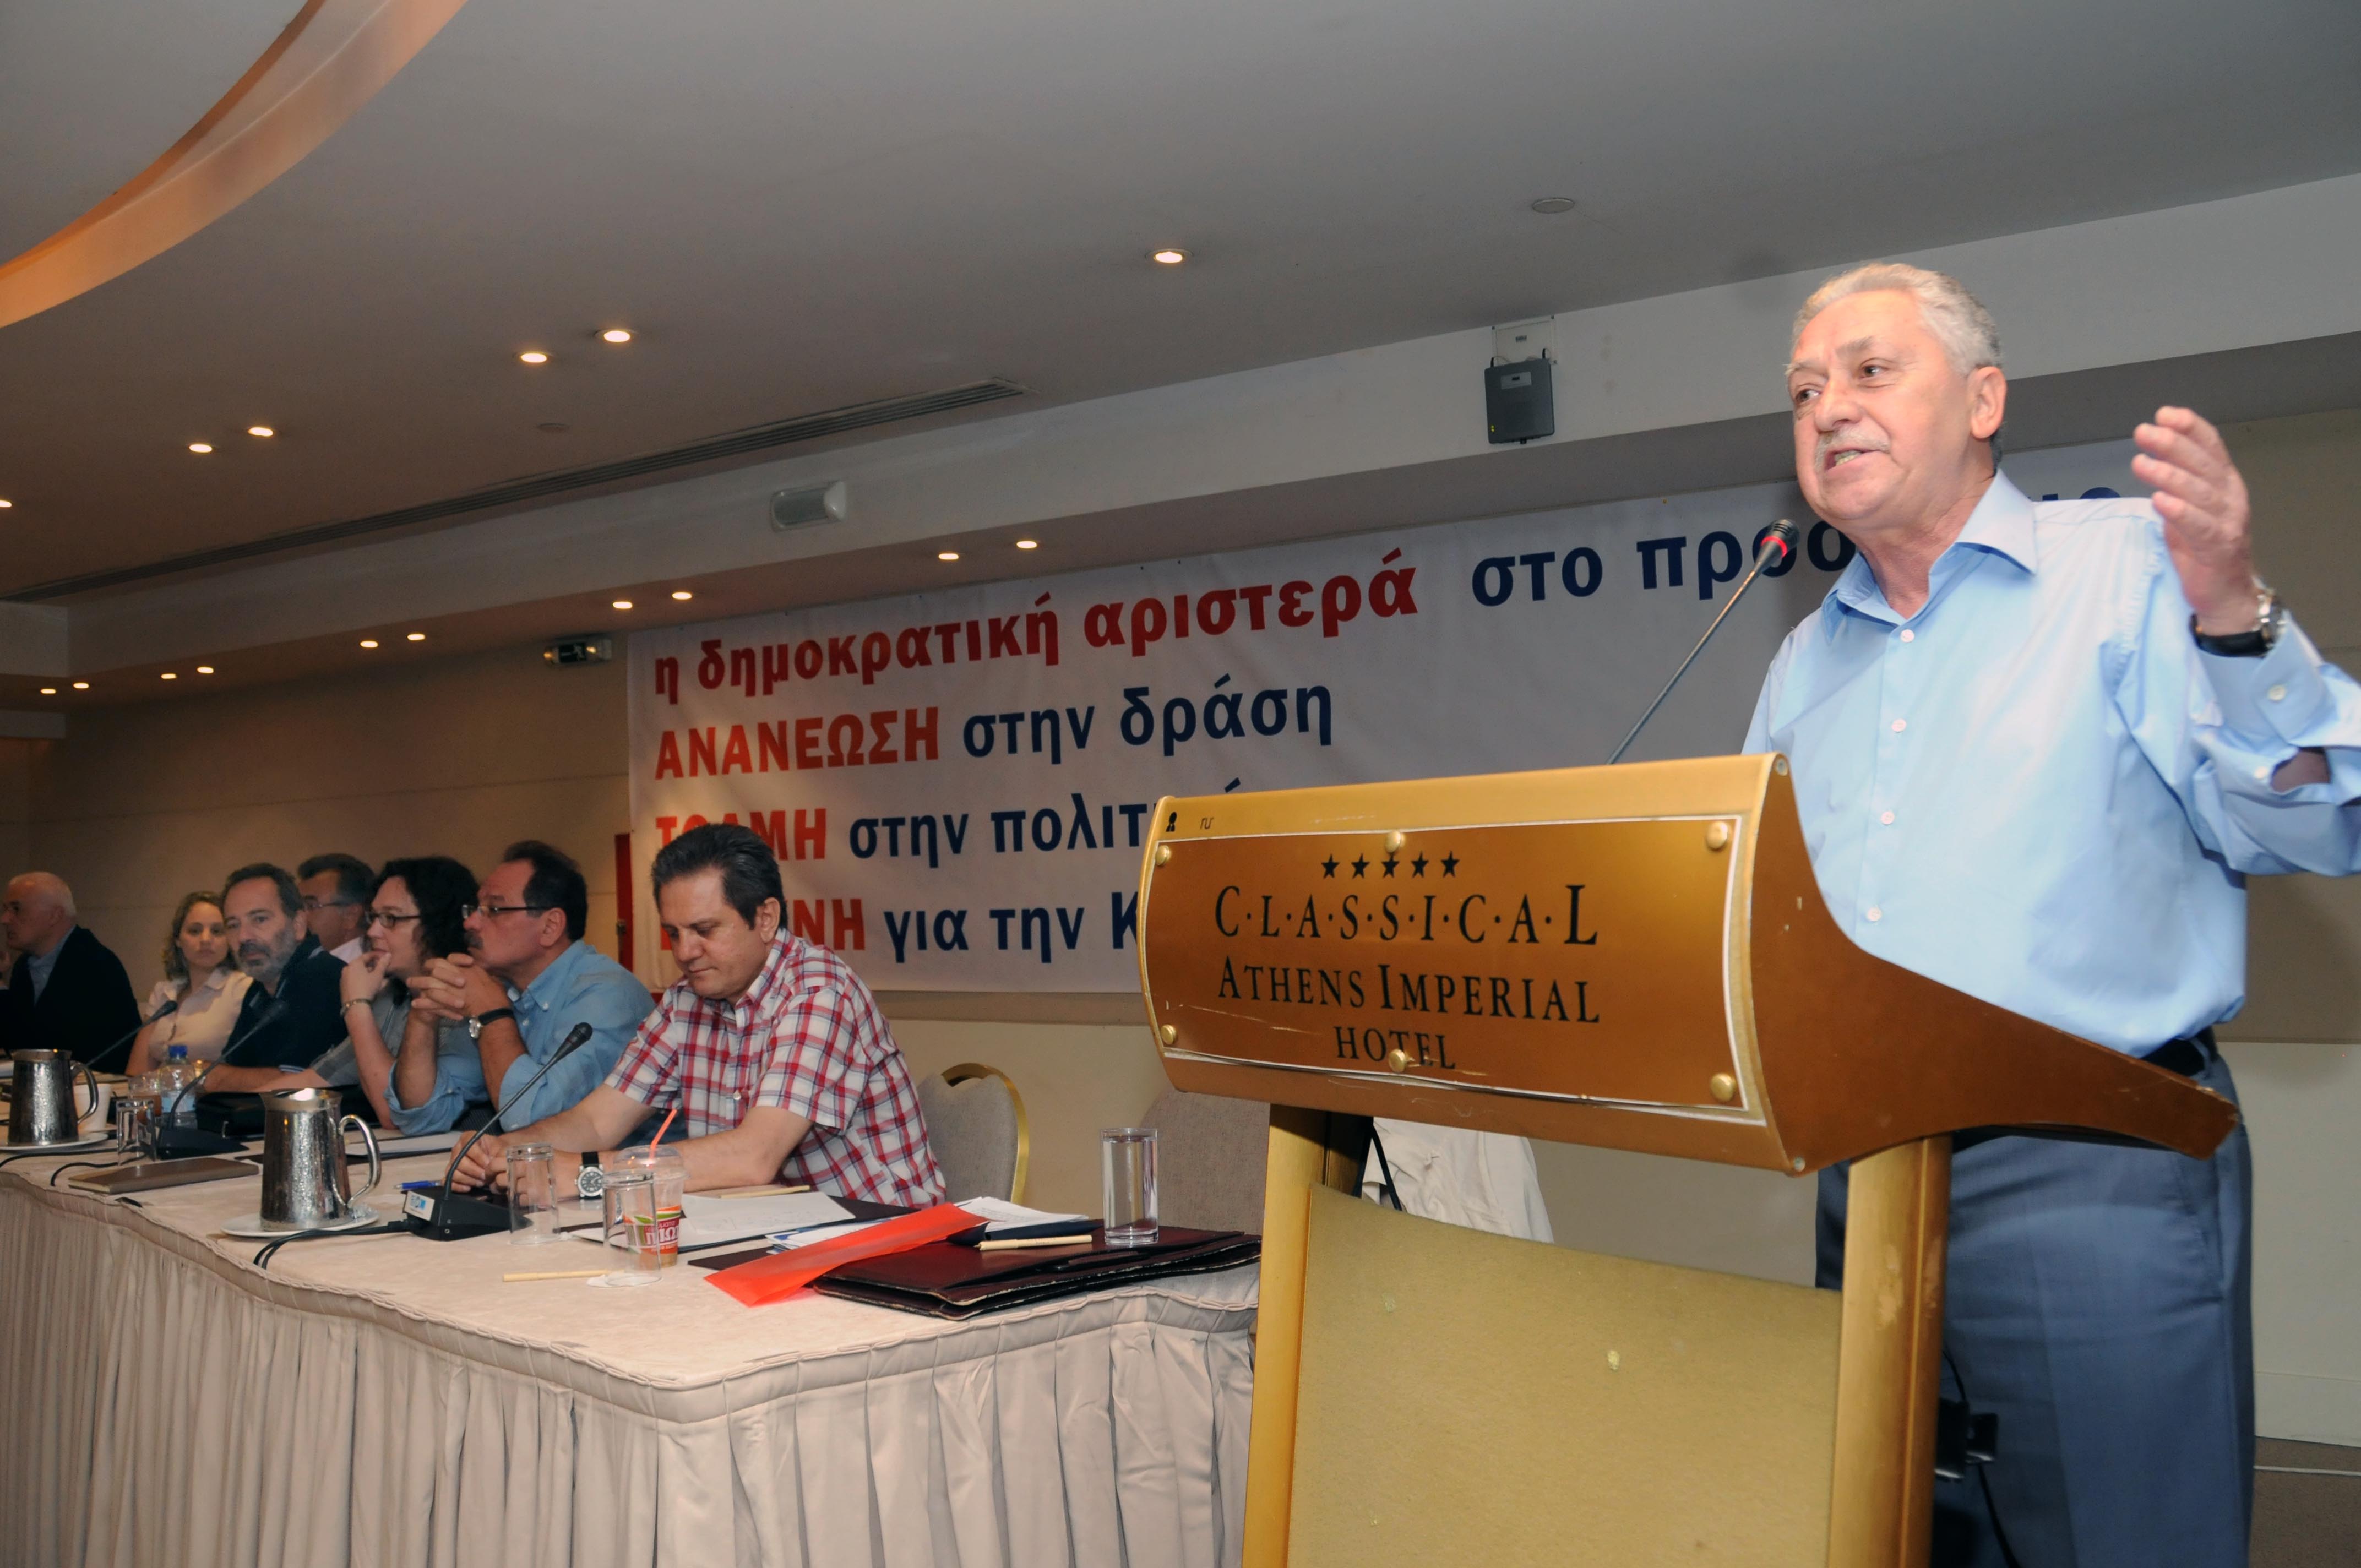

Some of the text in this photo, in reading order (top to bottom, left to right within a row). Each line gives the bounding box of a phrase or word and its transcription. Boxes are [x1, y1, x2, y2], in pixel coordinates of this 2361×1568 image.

[655, 655, 679, 705] η
[698, 592, 1059, 697] δημοκρατική
[1084, 547, 1418, 657] αριστερά
[1472, 547, 1603, 606] στο
[654, 673, 1331, 781] ΑΝΑΝΕΩΣΗ στην δράση
[850, 814, 969, 868] στην
[884, 909, 969, 963] για
[989, 907, 1085, 963] την
[1334, 1026, 1456, 1069] HOTEL
